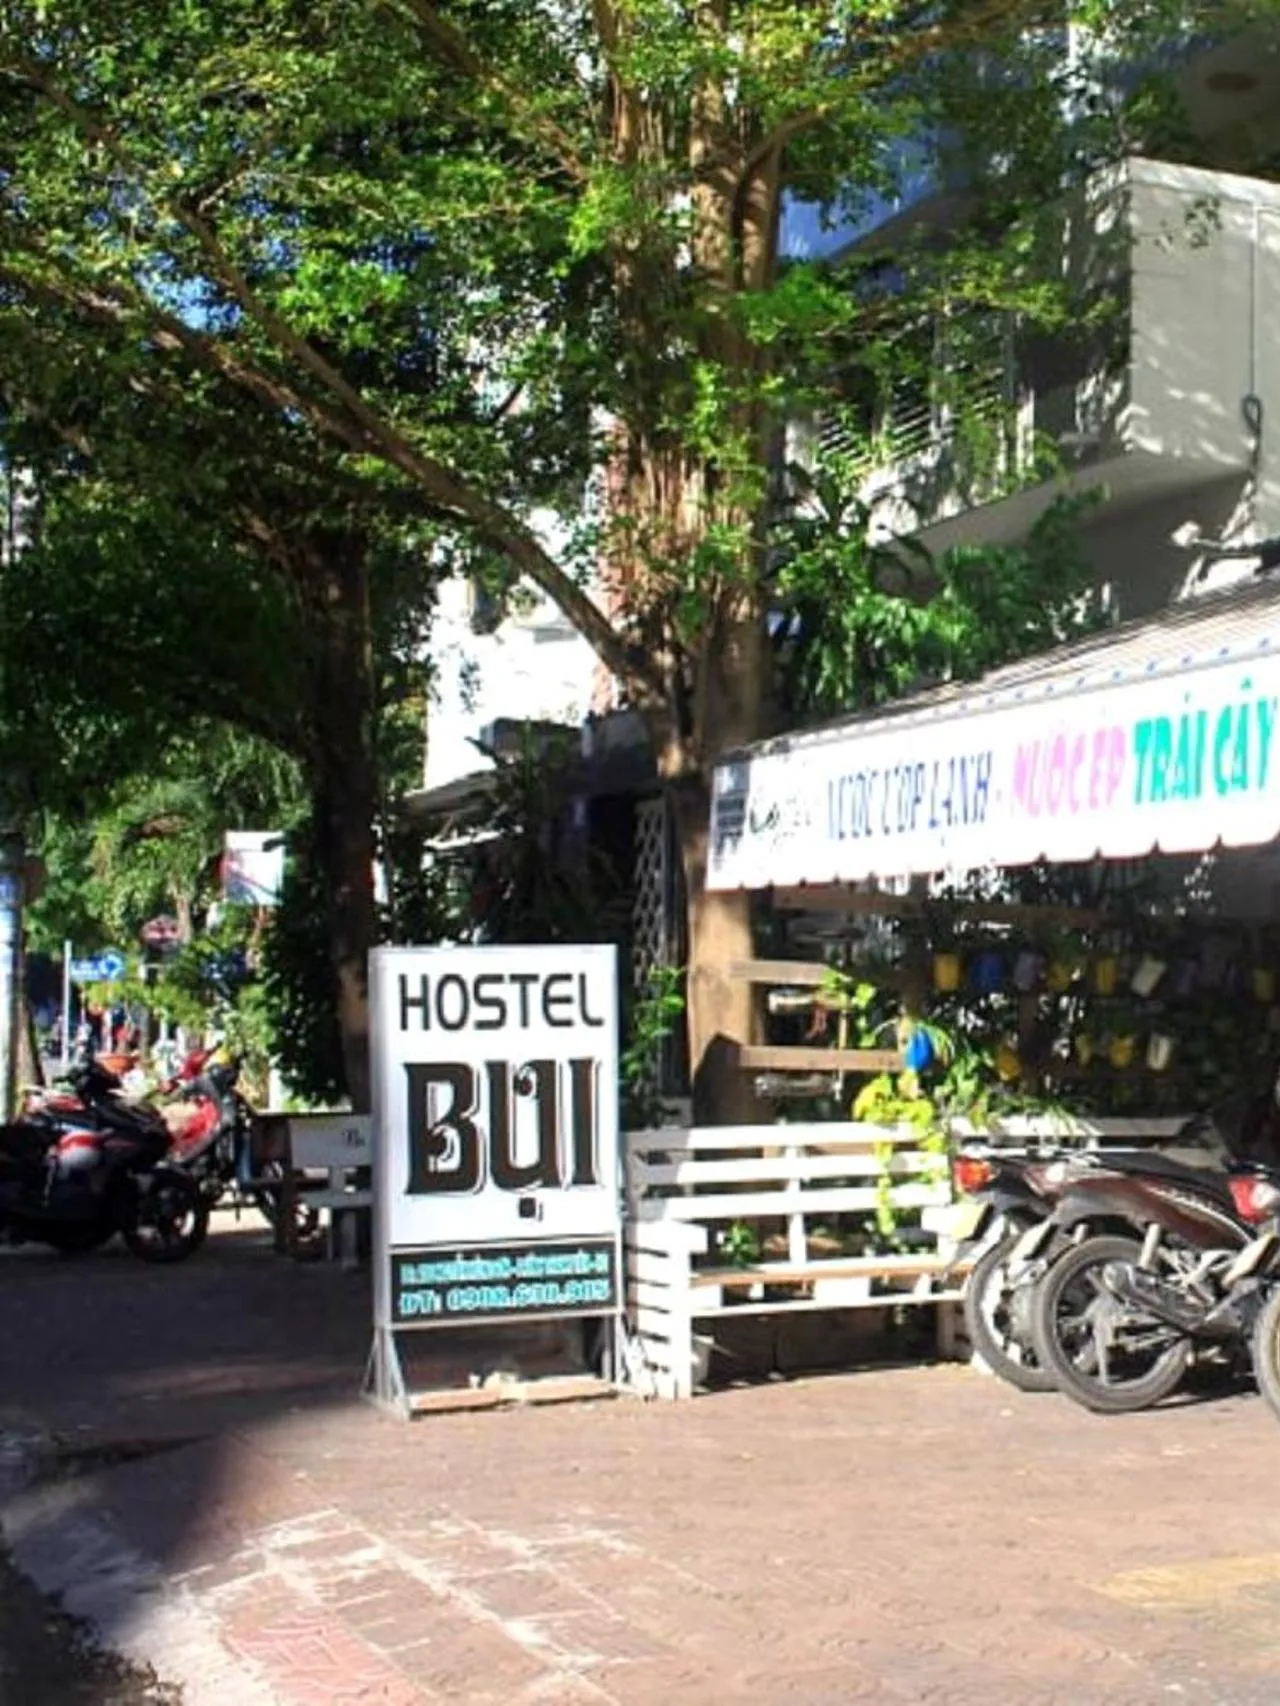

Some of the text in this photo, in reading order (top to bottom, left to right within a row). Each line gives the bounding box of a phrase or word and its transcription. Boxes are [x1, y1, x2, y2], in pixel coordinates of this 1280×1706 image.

[1133, 692, 1207, 806] TRÁI
[1213, 677, 1279, 798] CÂY
[399, 972, 605, 1032] HOSTEL
[402, 1057, 606, 1222] BỤI
